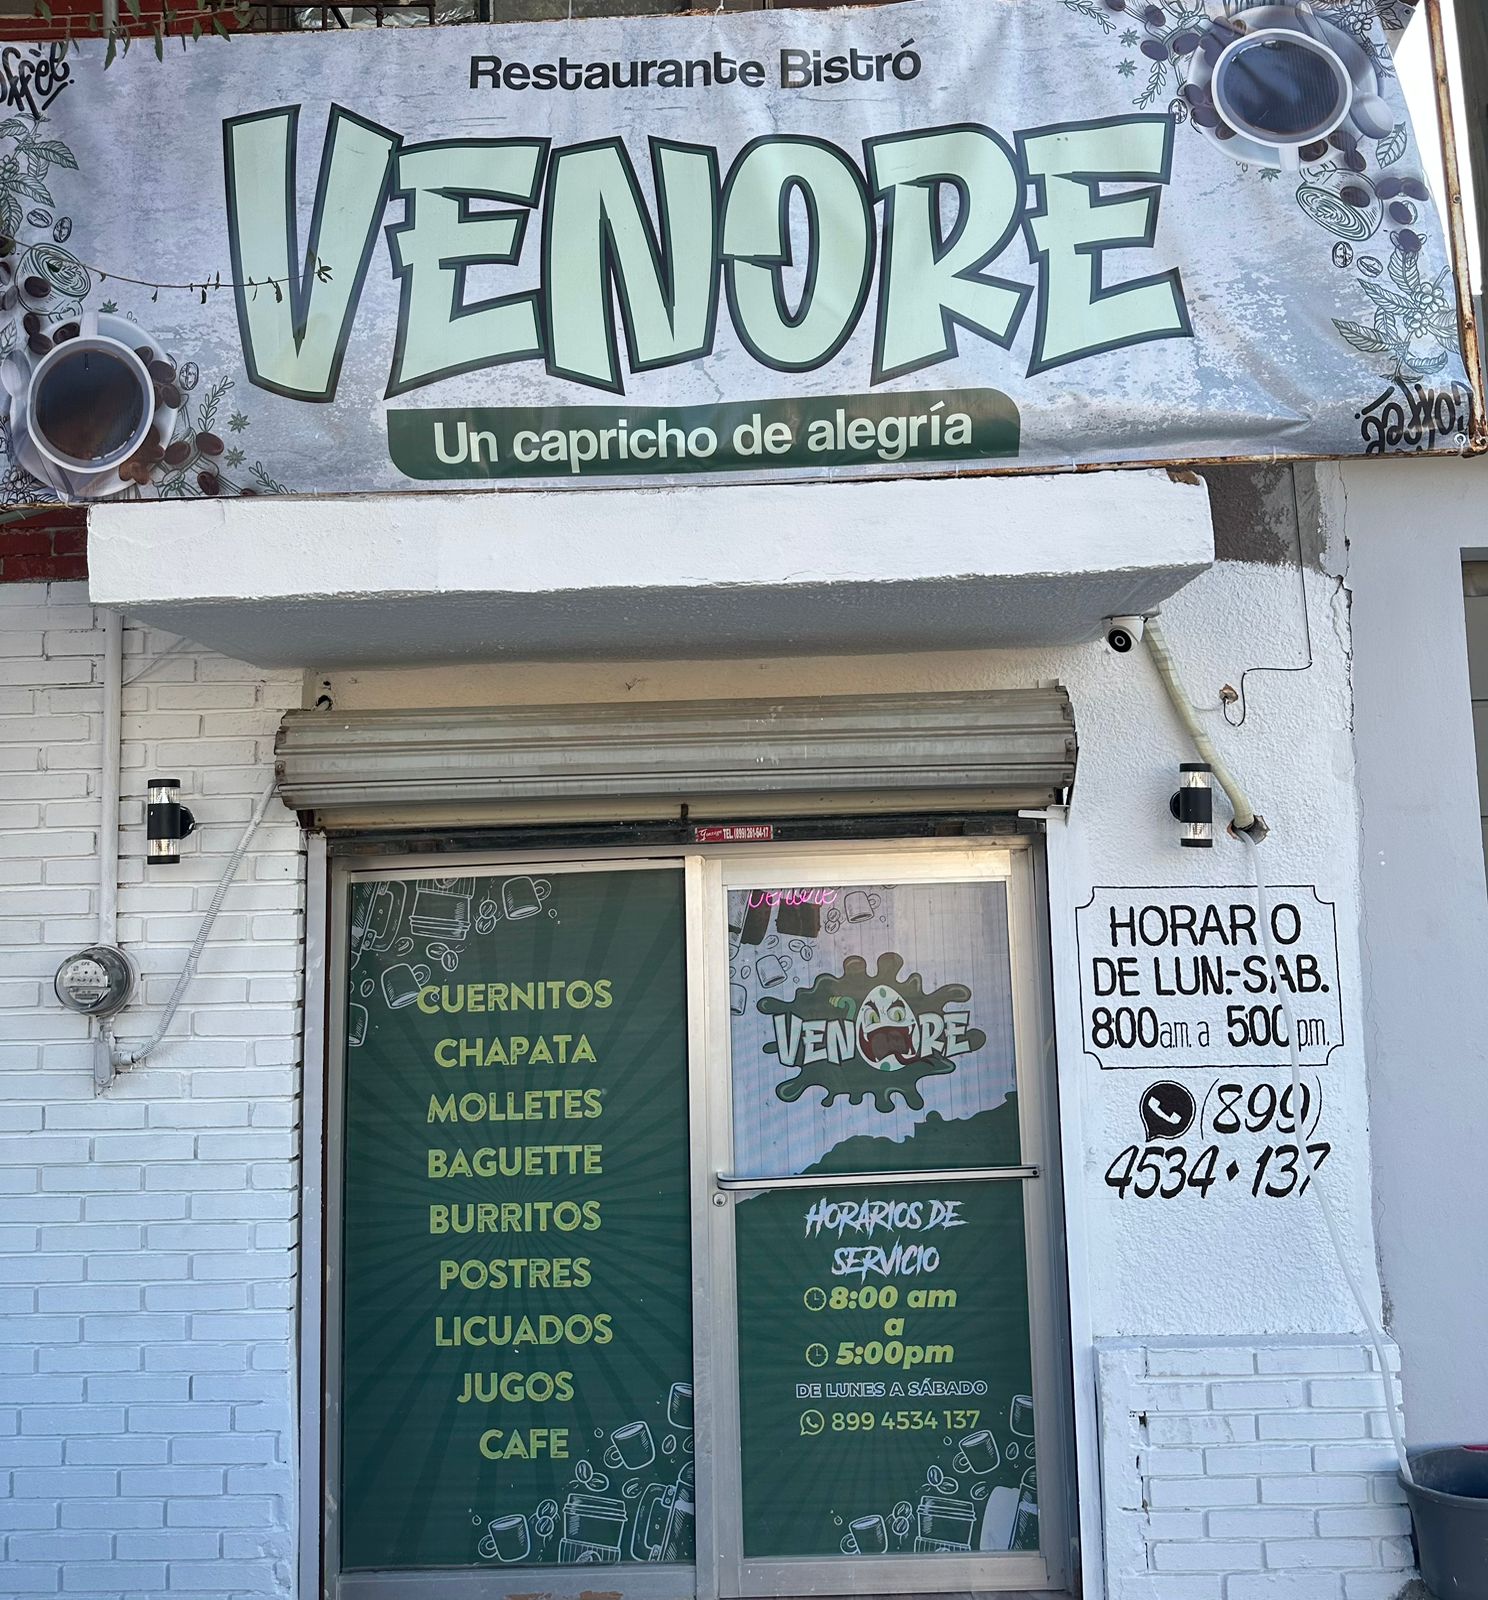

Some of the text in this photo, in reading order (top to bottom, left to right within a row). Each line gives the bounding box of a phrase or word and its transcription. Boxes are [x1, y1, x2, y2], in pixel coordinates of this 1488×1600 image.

[469, 38, 922, 90] Restaurante Bistró
[222, 100, 1194, 404] VENORE
[433, 401, 974, 474] Un capricho de alegría
[1109, 903, 1301, 947] HORARO
[1093, 957, 1141, 997] DE
[416, 979, 613, 1014] CUERNITOS
[434, 1034, 597, 1068] CHAPATA
[1197, 1021, 1210, 1047] a
[427, 1088, 603, 1123] MOLLETES
[1200, 1075, 1323, 1142] (899)
[427, 1144, 603, 1178] BAGUETTE
[429, 1200, 602, 1234] BURRITOS
[804, 1197, 969, 1239] HORARIOS DE
[440, 1257, 592, 1290] POSTRES
[831, 1236, 940, 1284] SERVICIO
[829, 1285, 957, 1310] 8:00 am
[435, 1313, 613, 1347] LICUADOS
[884, 1317, 905, 1337] a
[835, 1340, 955, 1370] 5:00pm
[457, 1371, 574, 1403] JUGOS
[796, 1377, 988, 1399] DE LUNES A SÁBADO
[831, 1409, 981, 1432] 899 4534 137
[479, 1428, 569, 1460] CAFE
